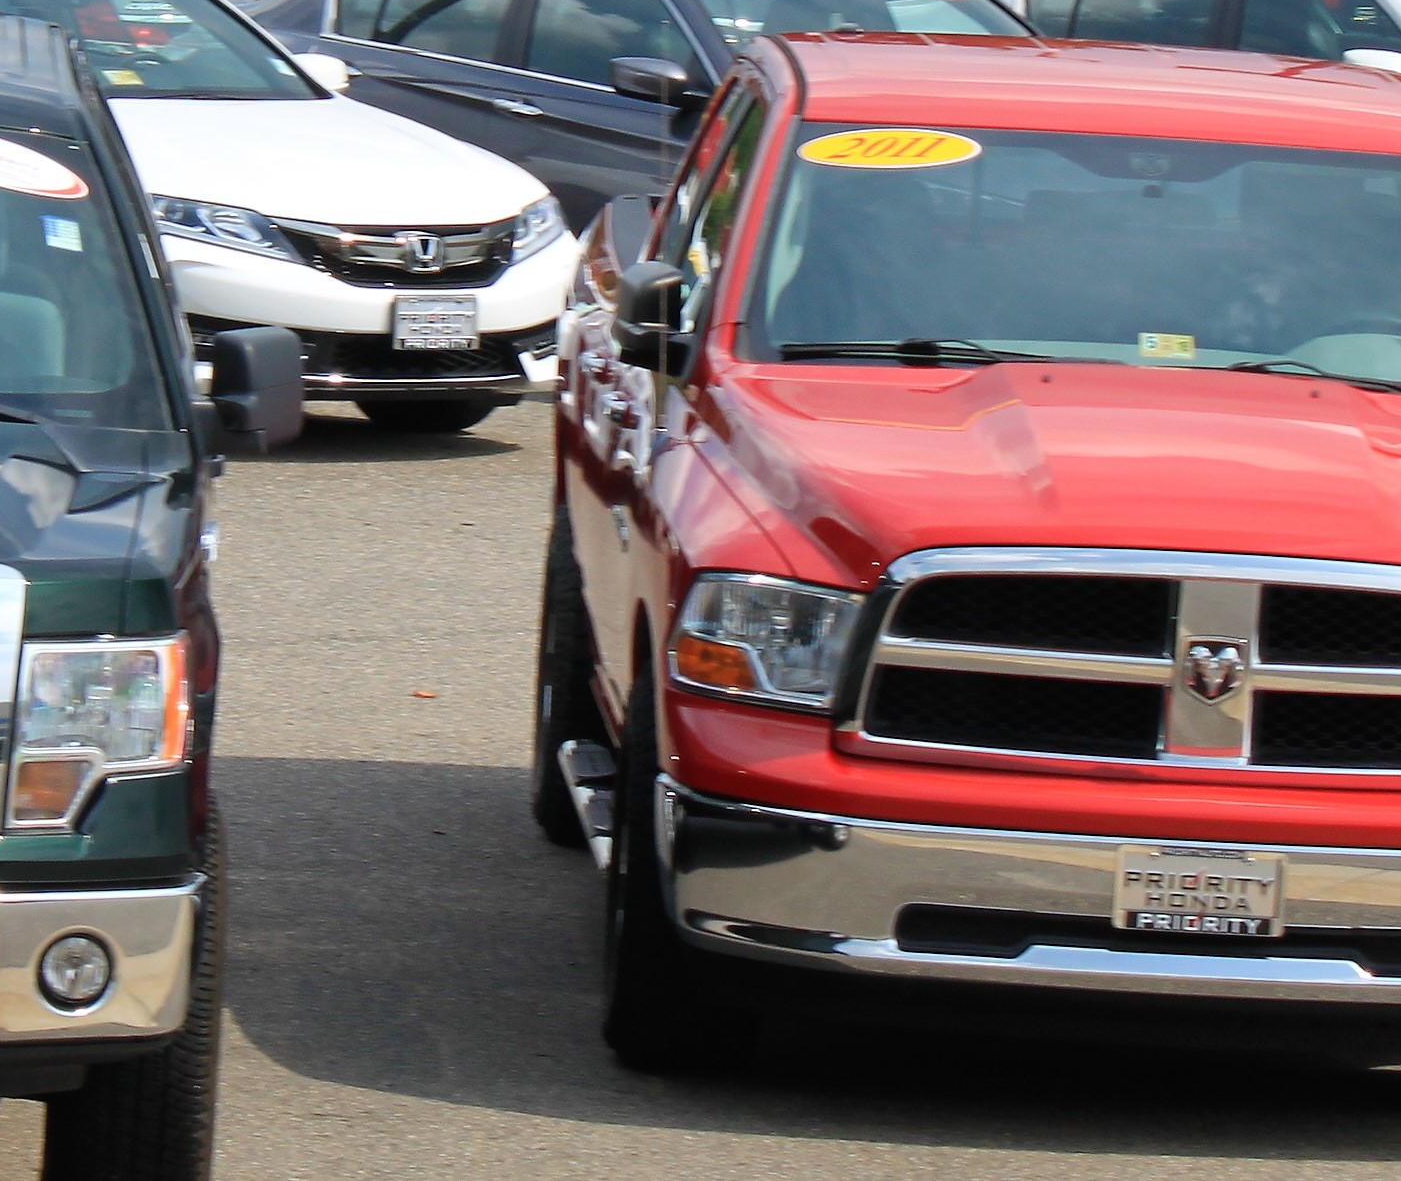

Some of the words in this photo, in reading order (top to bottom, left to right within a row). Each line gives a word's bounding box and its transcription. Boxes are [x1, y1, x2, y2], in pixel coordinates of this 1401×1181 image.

[824, 136, 949, 159] 2011
[1125, 869, 1275, 894] PRIORITY
[1146, 890, 1252, 911] HONDA
[1135, 912, 1263, 935] PRIORITY
